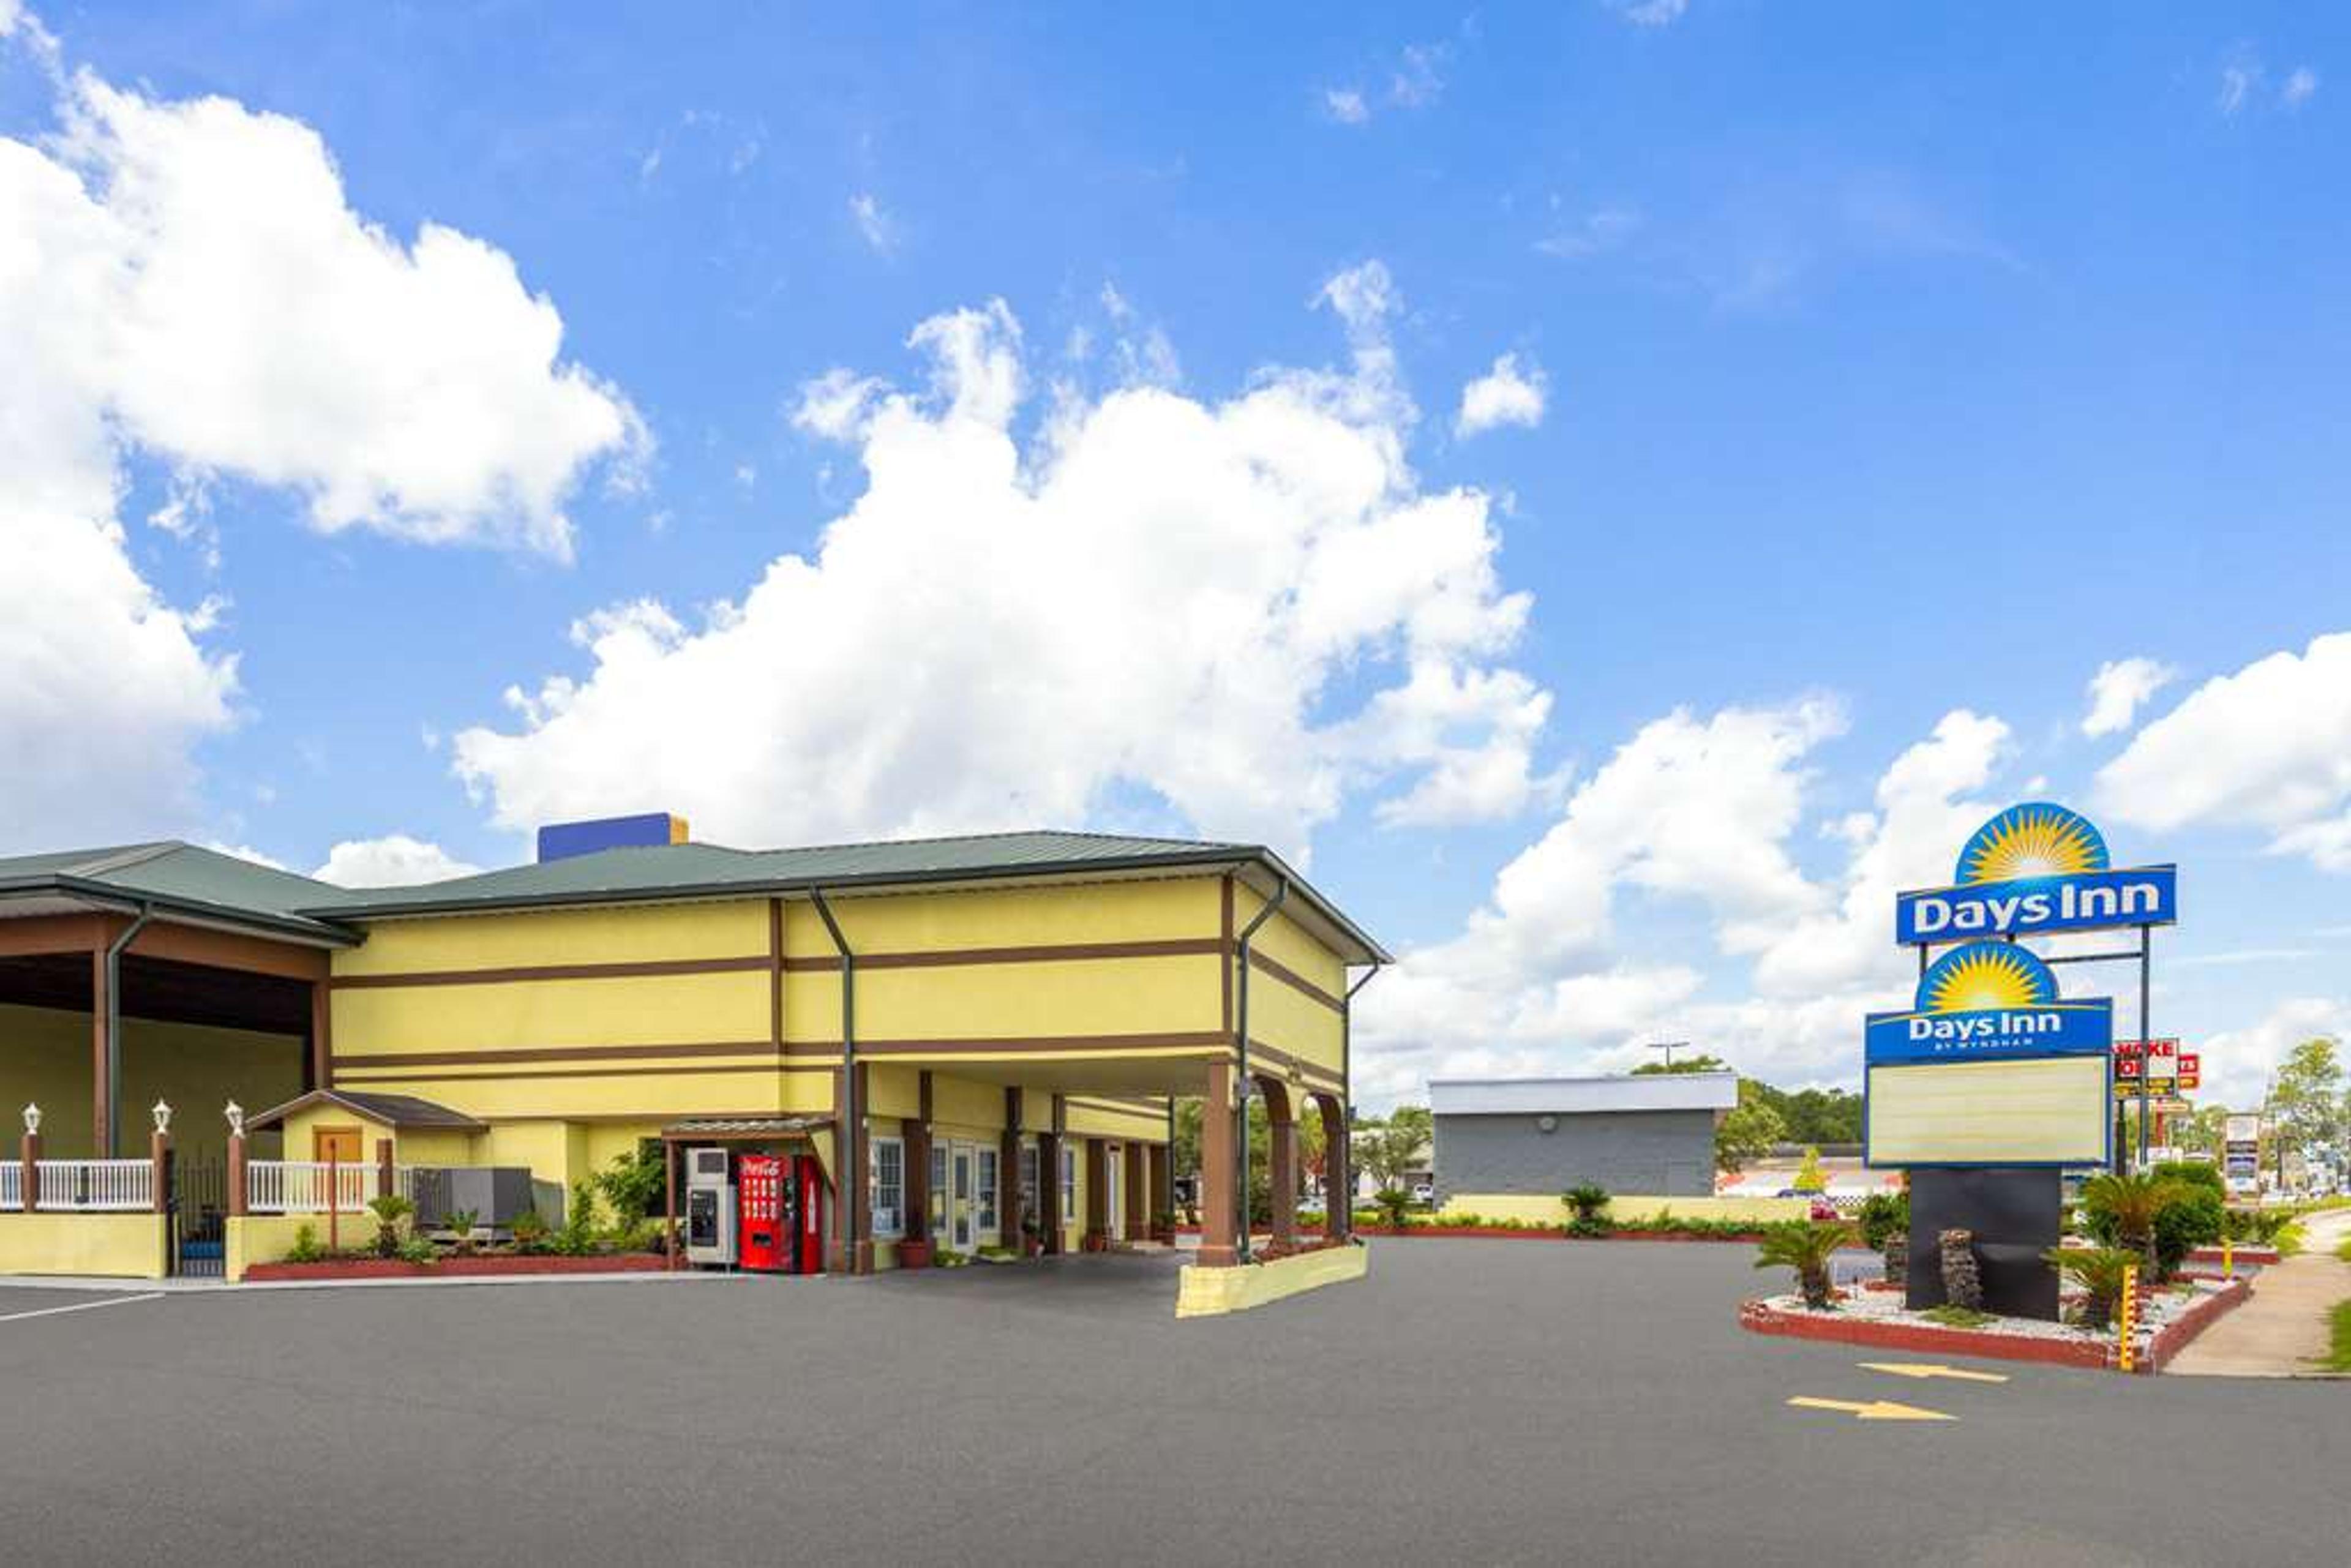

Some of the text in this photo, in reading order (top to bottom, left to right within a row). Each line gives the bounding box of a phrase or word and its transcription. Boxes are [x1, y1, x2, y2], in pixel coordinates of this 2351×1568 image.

[1914, 883, 2160, 933] Days Inn
[1910, 1011, 2061, 1040] Days Inn
